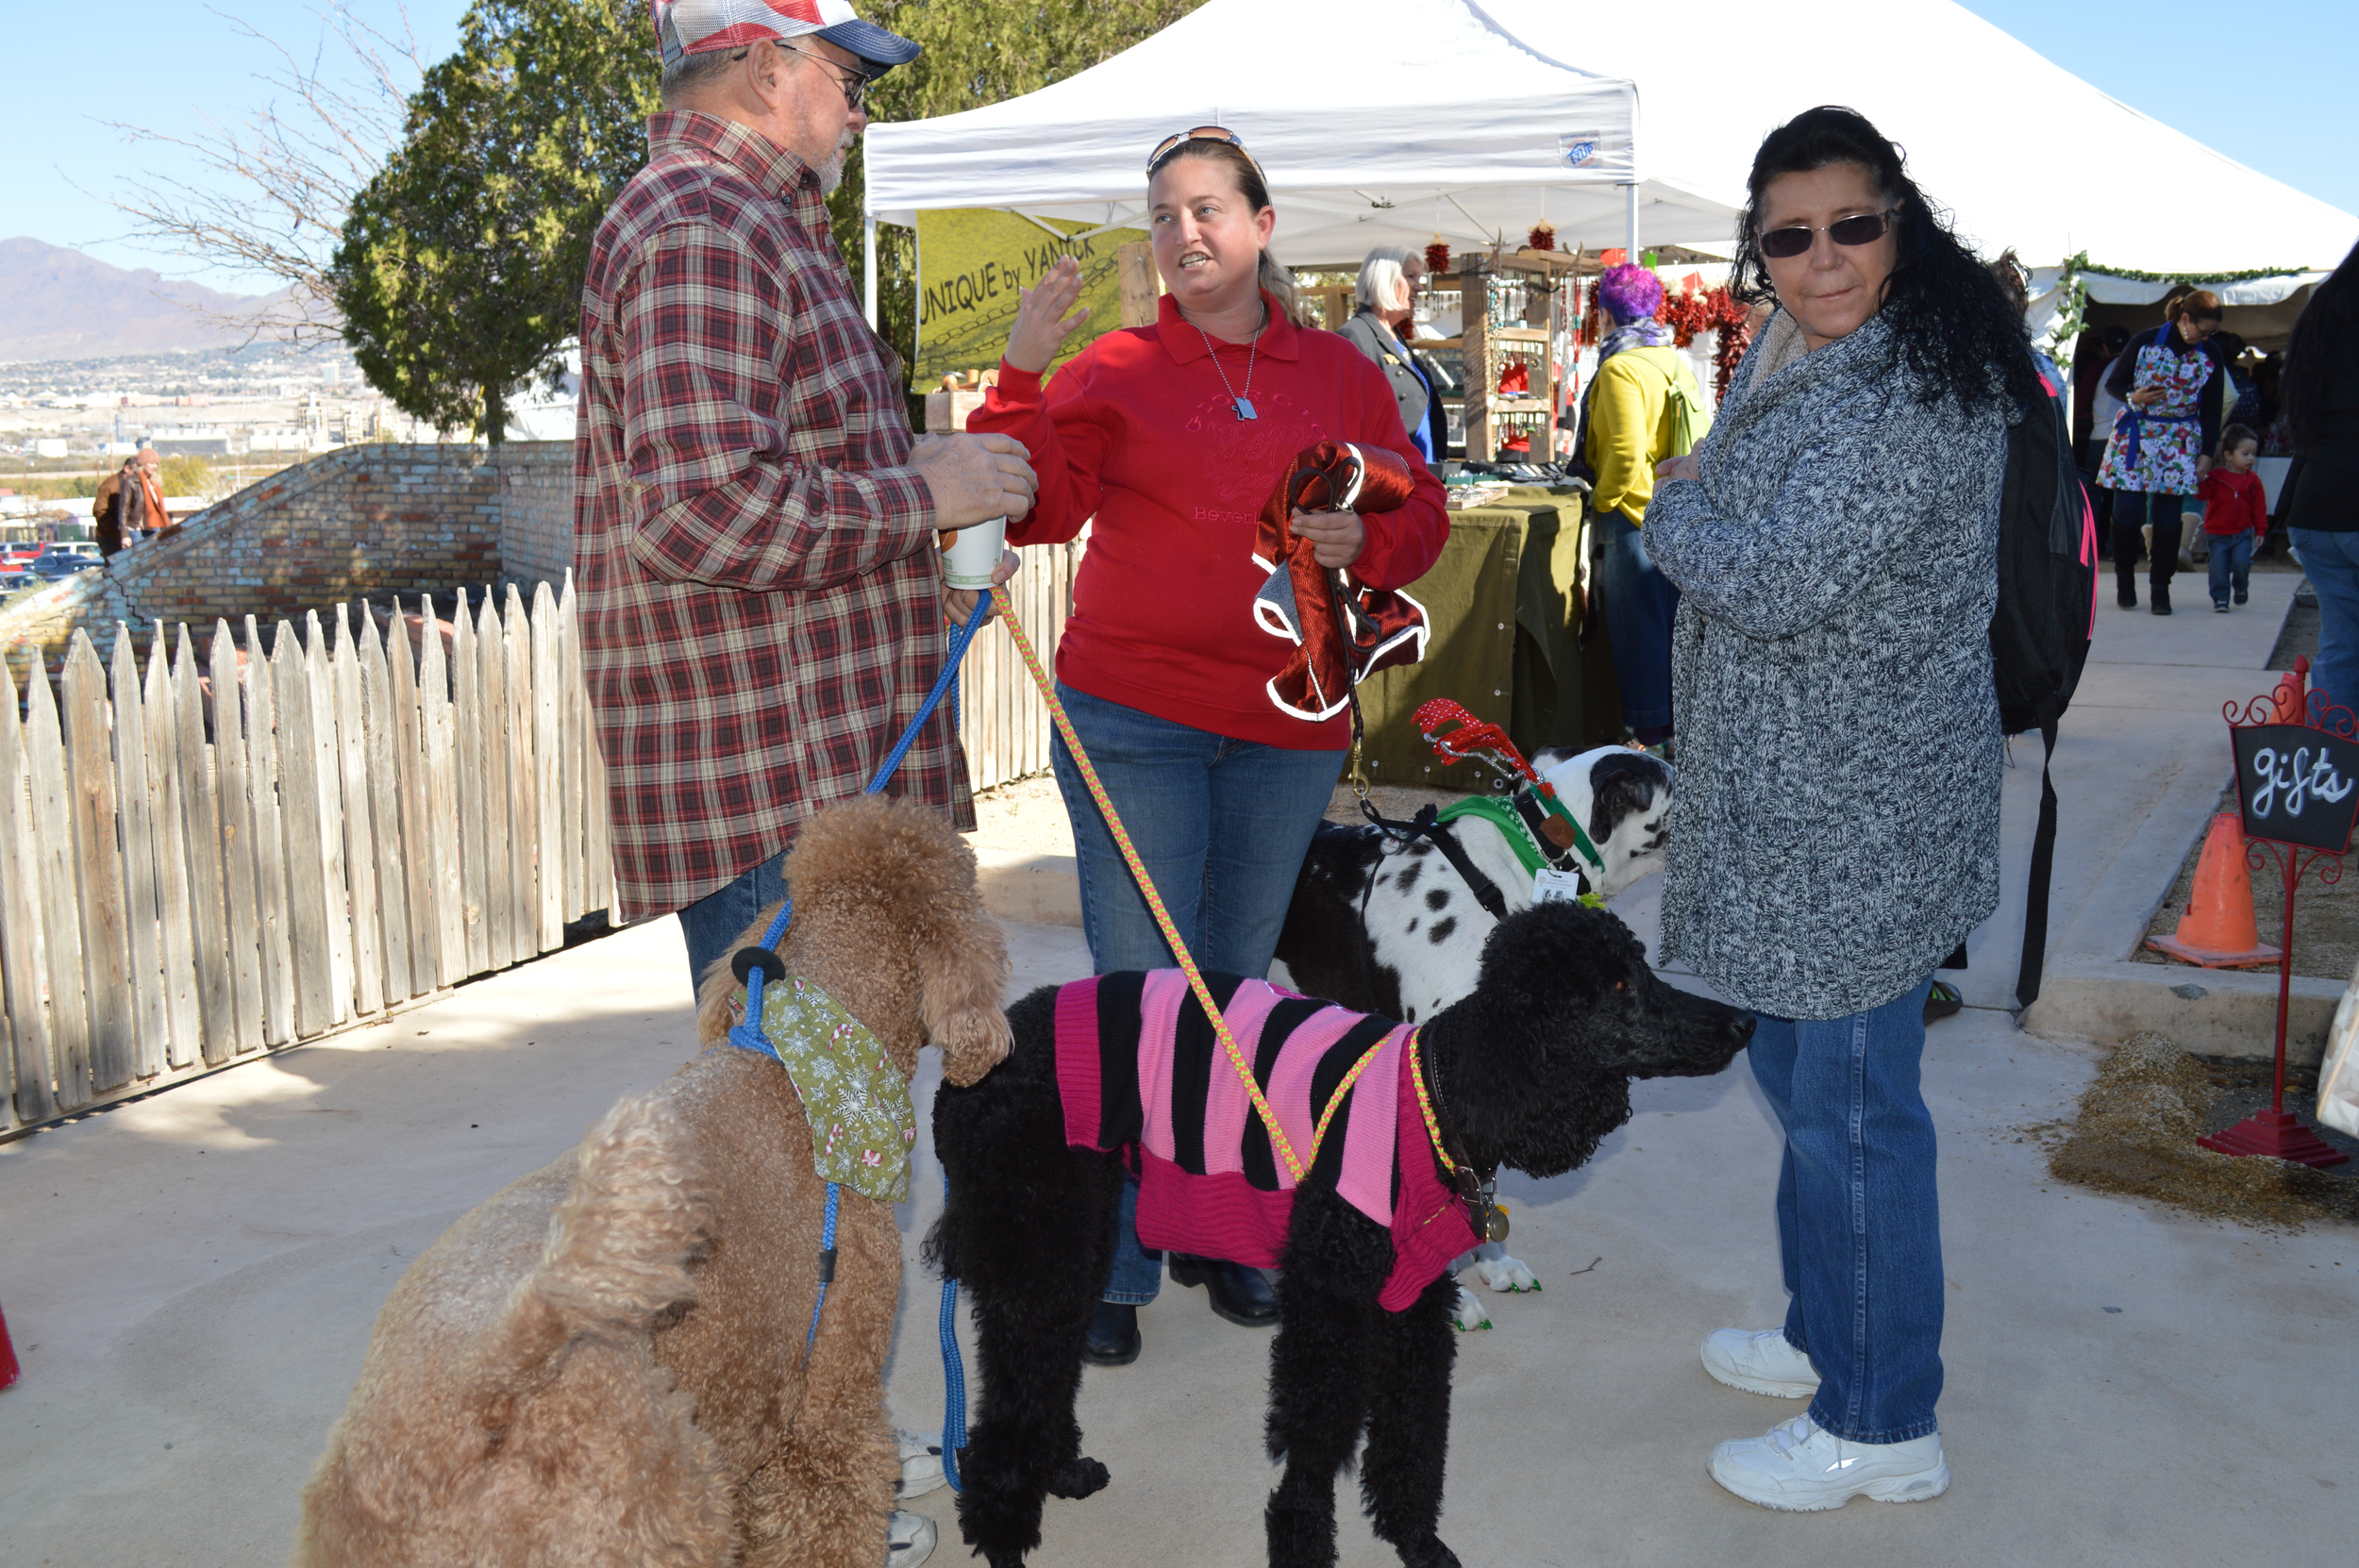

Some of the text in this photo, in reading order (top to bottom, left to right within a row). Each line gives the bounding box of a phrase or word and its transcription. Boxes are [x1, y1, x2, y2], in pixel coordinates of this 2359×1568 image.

[920, 261, 997, 325] UNIQUE
[1002, 263, 1020, 295] by
[1194, 506, 1260, 525] Beverl
[2252, 746, 2353, 819] gifts
